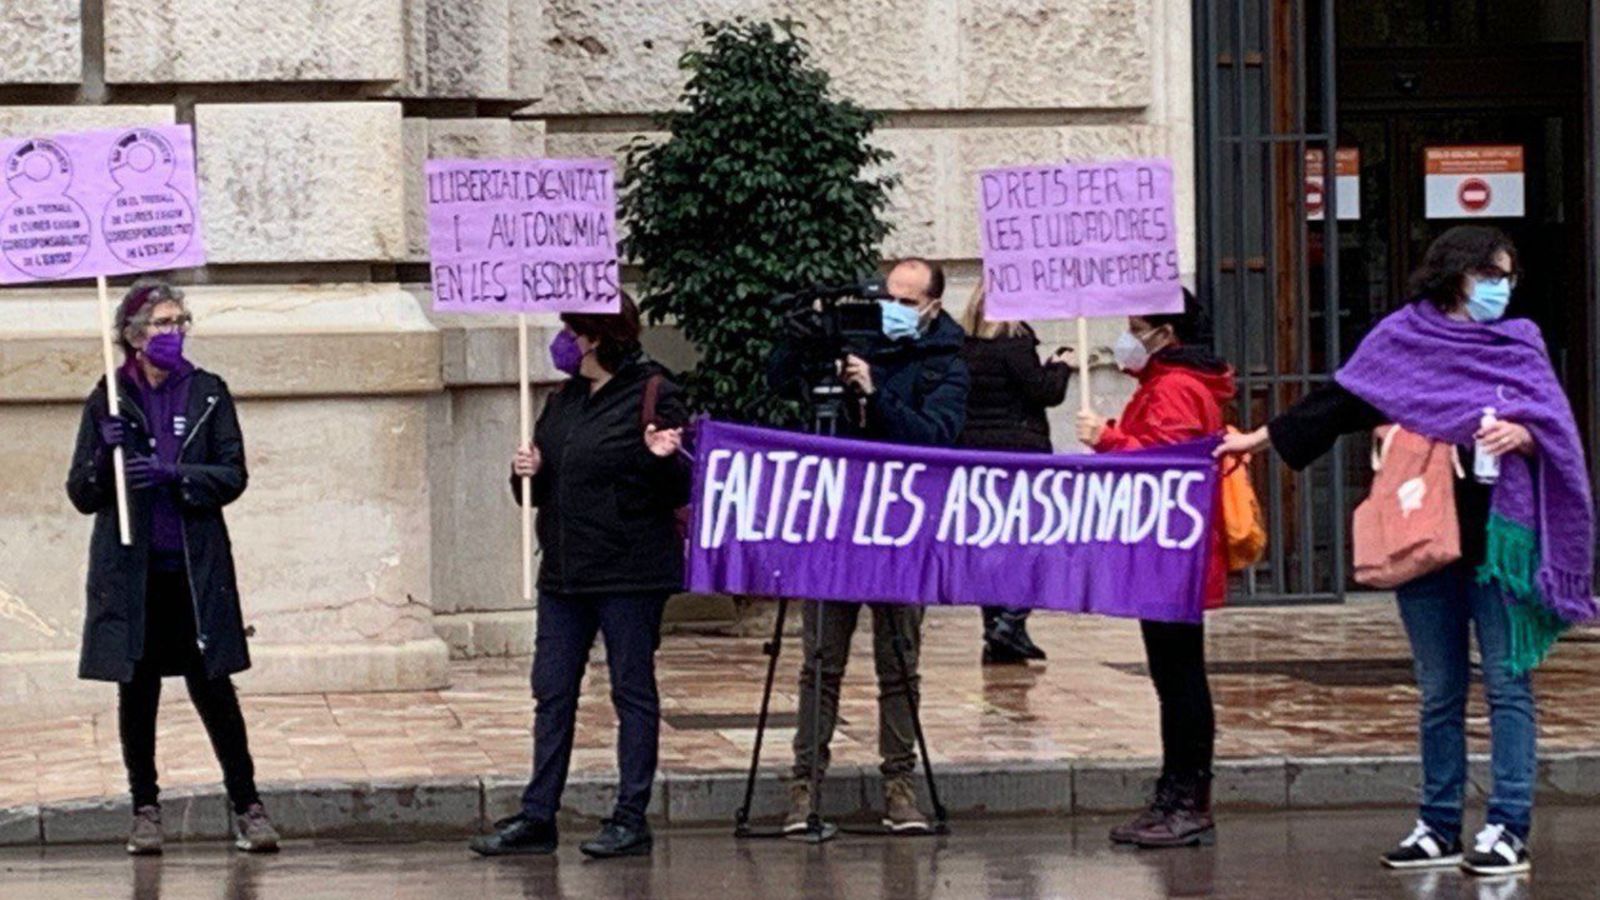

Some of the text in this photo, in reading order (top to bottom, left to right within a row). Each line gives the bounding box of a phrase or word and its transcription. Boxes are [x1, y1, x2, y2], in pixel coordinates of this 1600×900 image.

[526, 168, 609, 200] DIGNITAT
[982, 167, 1154, 211] DRETS PER A
[453, 211, 611, 252] I AUTONOMIA
[986, 207, 1167, 251] LES CUIDADORES
[435, 265, 464, 301] EN
[472, 260, 507, 302] LES
[989, 250, 1179, 293] NO REMUNERADES
[700, 449, 1206, 550] FALTEN LES ASSASSINADES
